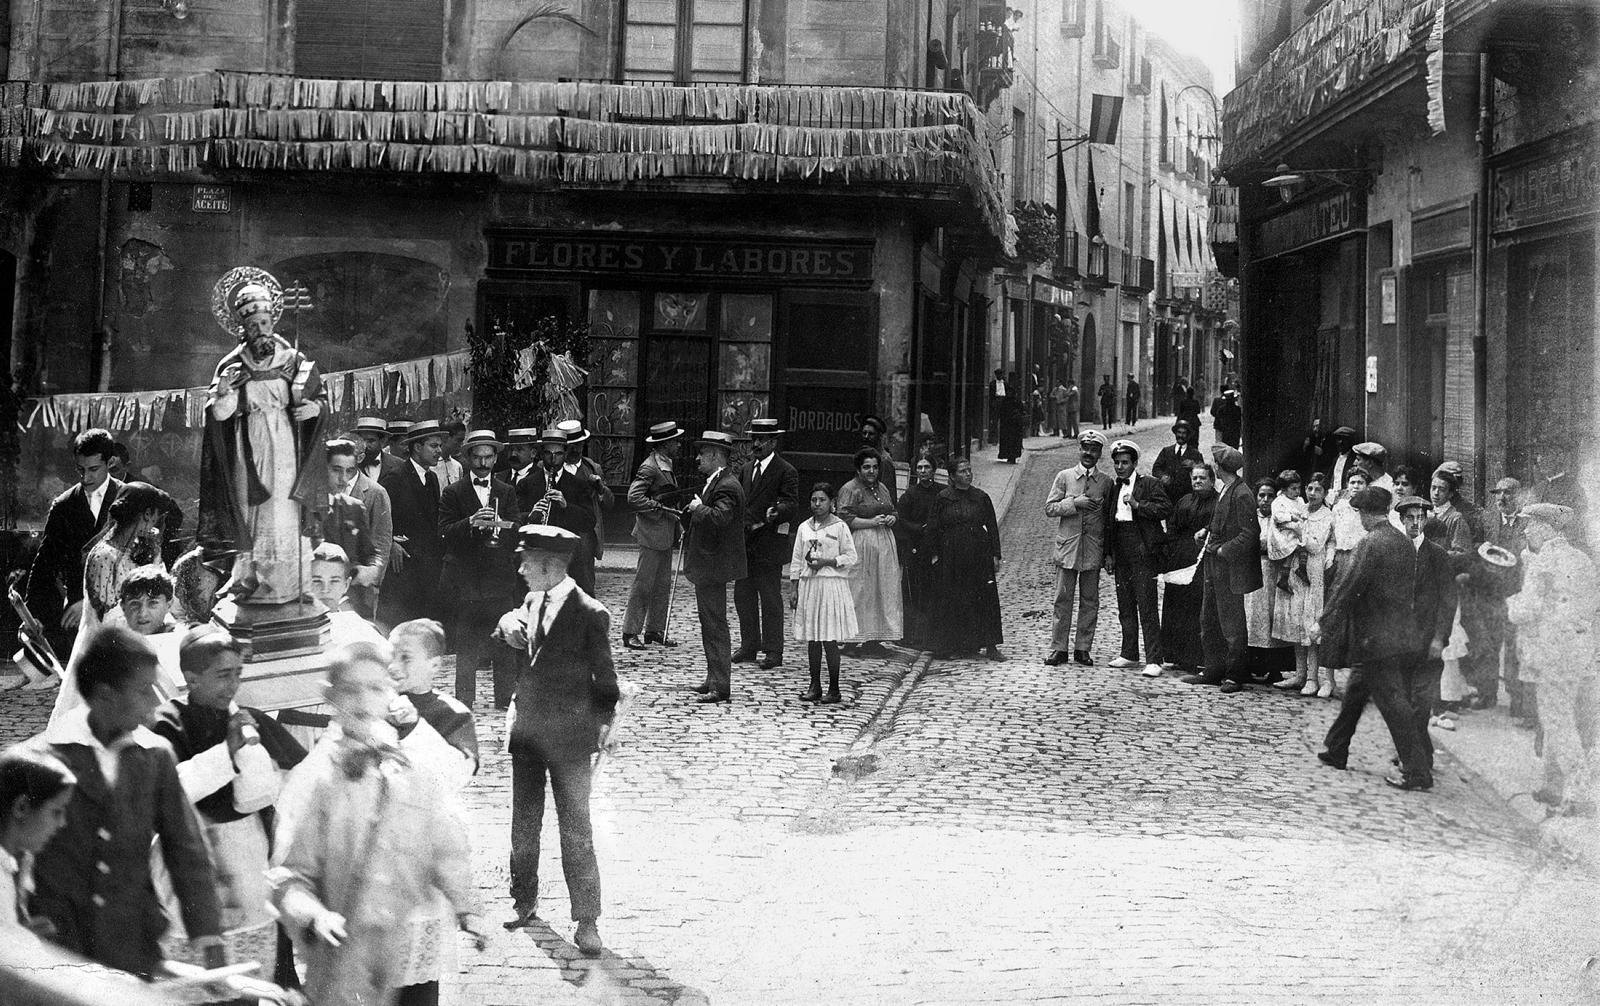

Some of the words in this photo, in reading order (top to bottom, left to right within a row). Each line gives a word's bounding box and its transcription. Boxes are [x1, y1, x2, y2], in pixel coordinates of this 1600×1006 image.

[195, 199, 228, 210] ACEITE
[1299, 192, 1350, 241] ATEU
[504, 241, 645, 269] FLORES
[662, 247, 682, 269] Y
[694, 247, 855, 276] LABORES
[788, 406, 860, 432] BORDADOS
